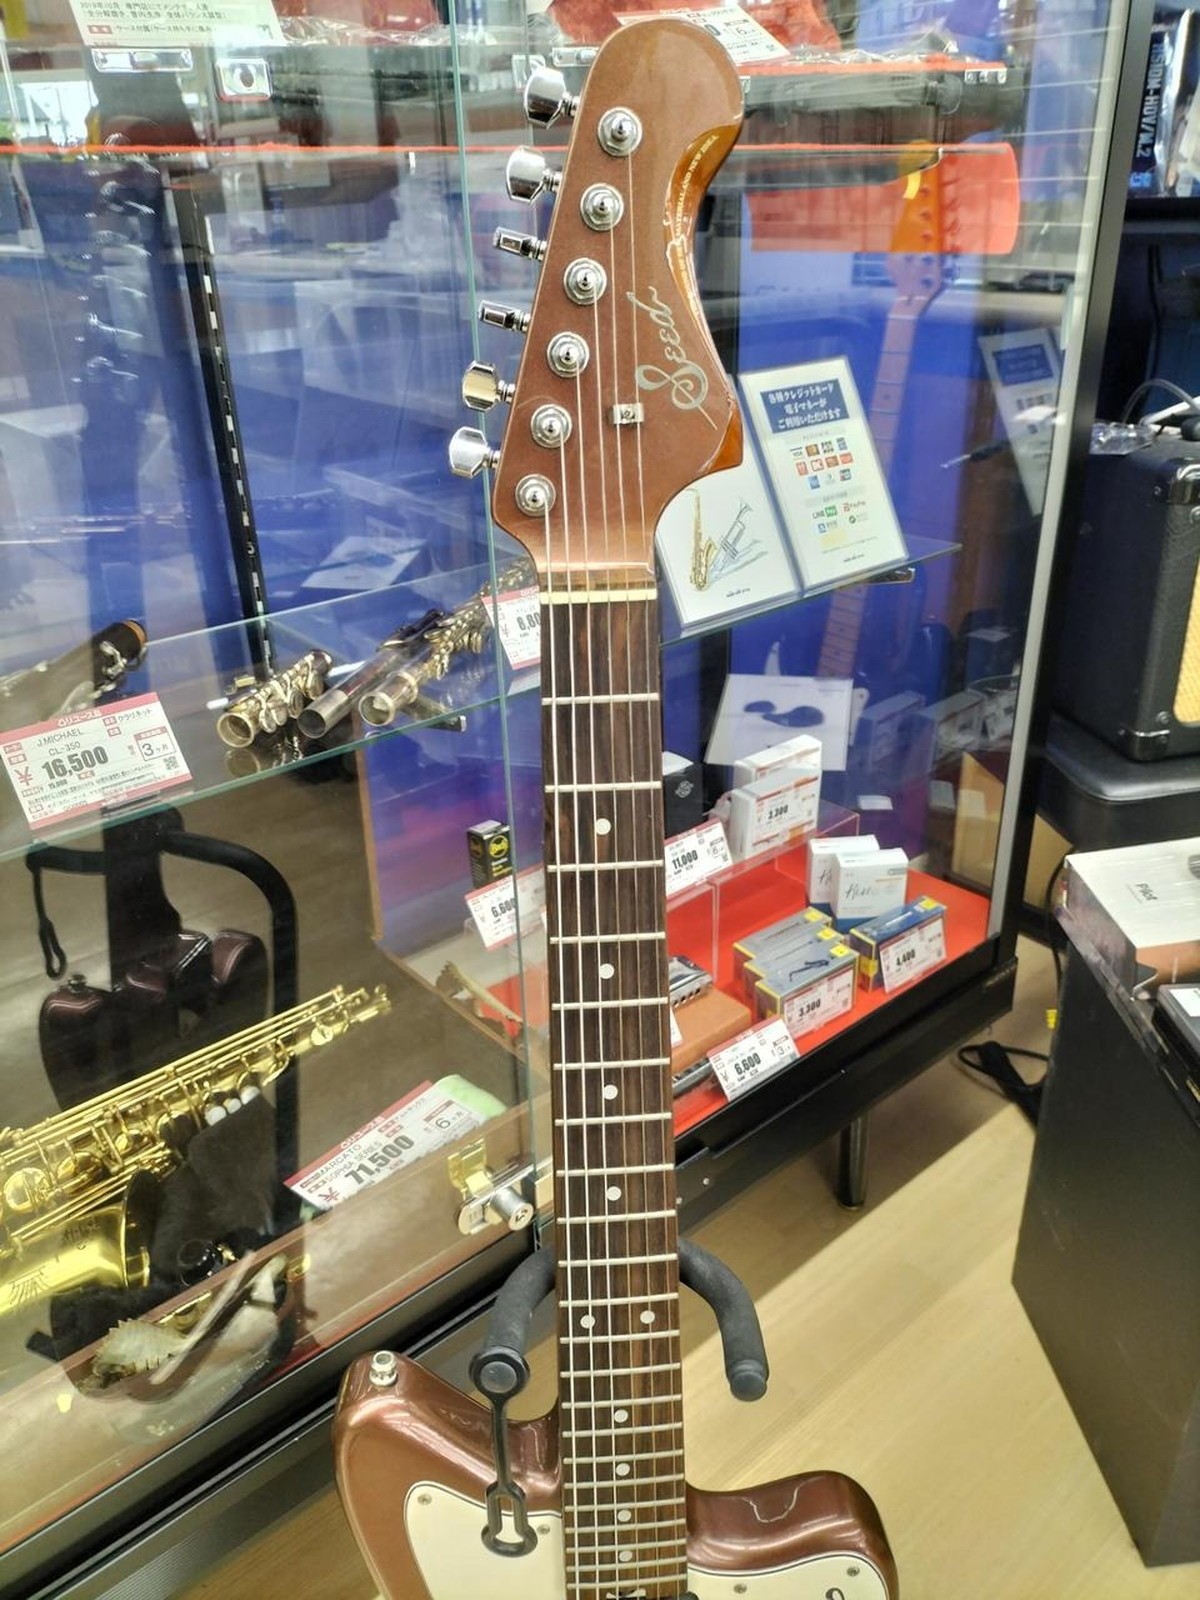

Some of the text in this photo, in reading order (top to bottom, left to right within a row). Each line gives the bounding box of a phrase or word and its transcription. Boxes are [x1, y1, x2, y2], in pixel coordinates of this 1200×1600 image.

[768, 382, 834, 404] 各種クレジットカード
[784, 398, 827, 416] 電子マネーが
[777, 408, 841, 430] ご利用いただけます
[118, 708, 152, 722] クラリネット
[48, 741, 81, 757] CL-350
[42, 746, 109, 779] 16,500
[671, 850, 699, 870] 11,000
[734, 1053, 761, 1076] 6,600
[344, 1134, 415, 1185] 71,500
